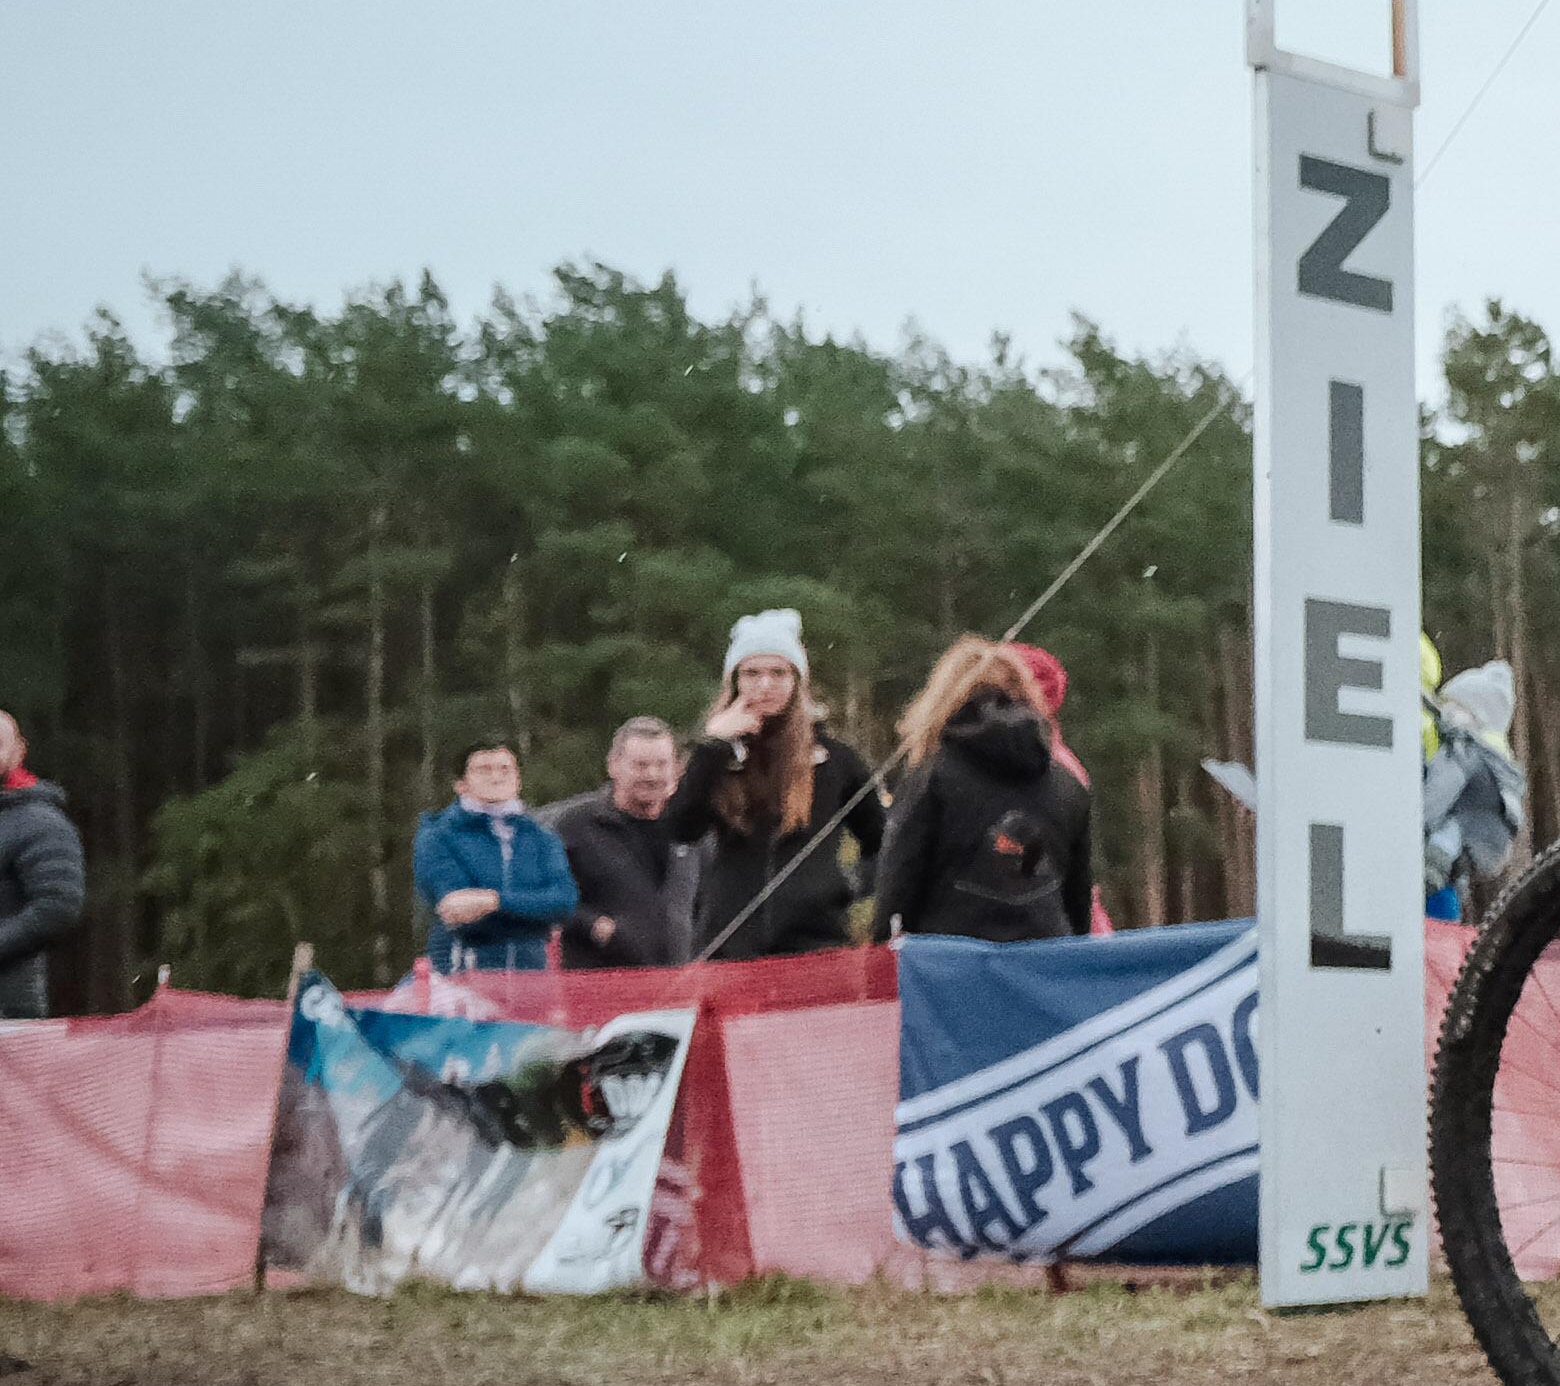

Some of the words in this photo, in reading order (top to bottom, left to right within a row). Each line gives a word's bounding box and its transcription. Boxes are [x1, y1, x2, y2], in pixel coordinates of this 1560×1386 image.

[1298, 153, 1394, 971] ZIEL
[893, 1060, 1153, 1260] HAPPY
[1300, 1220, 1411, 1274] SSVS
